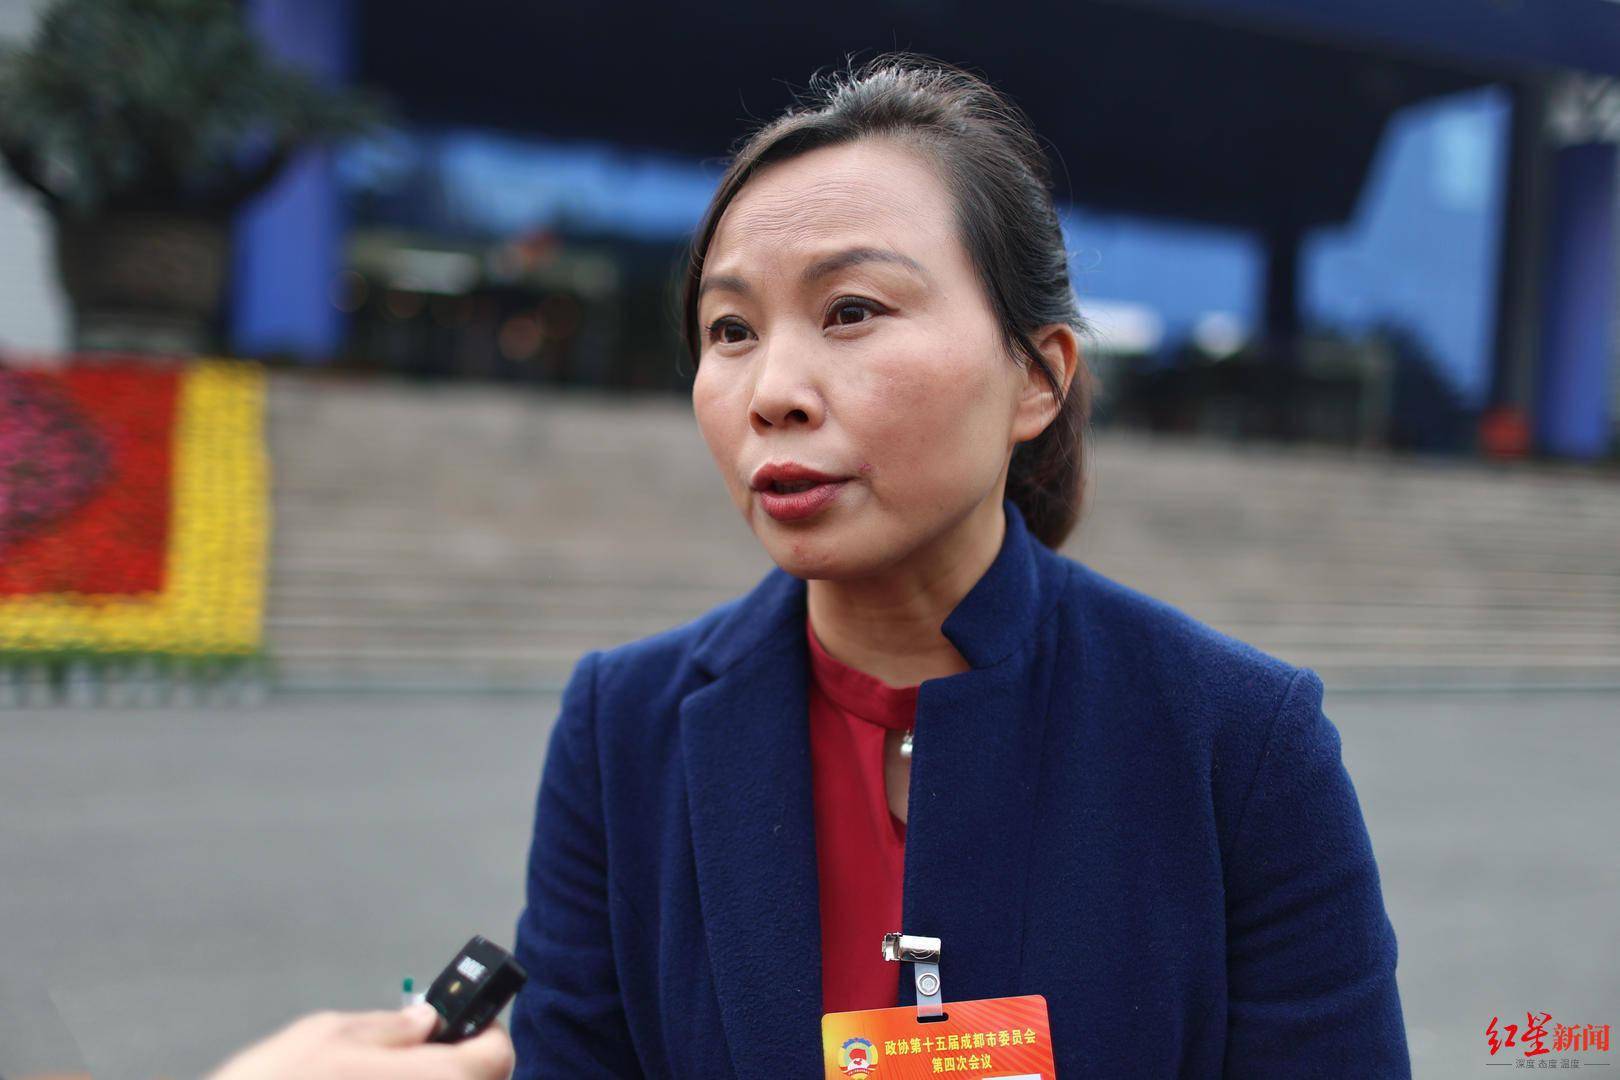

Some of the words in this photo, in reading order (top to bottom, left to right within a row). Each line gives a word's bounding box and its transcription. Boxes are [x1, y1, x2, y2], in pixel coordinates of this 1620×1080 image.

[884, 1027, 1037, 1056] 政协第十五届成都市委员会
[931, 1053, 993, 1074] 第四次会议
